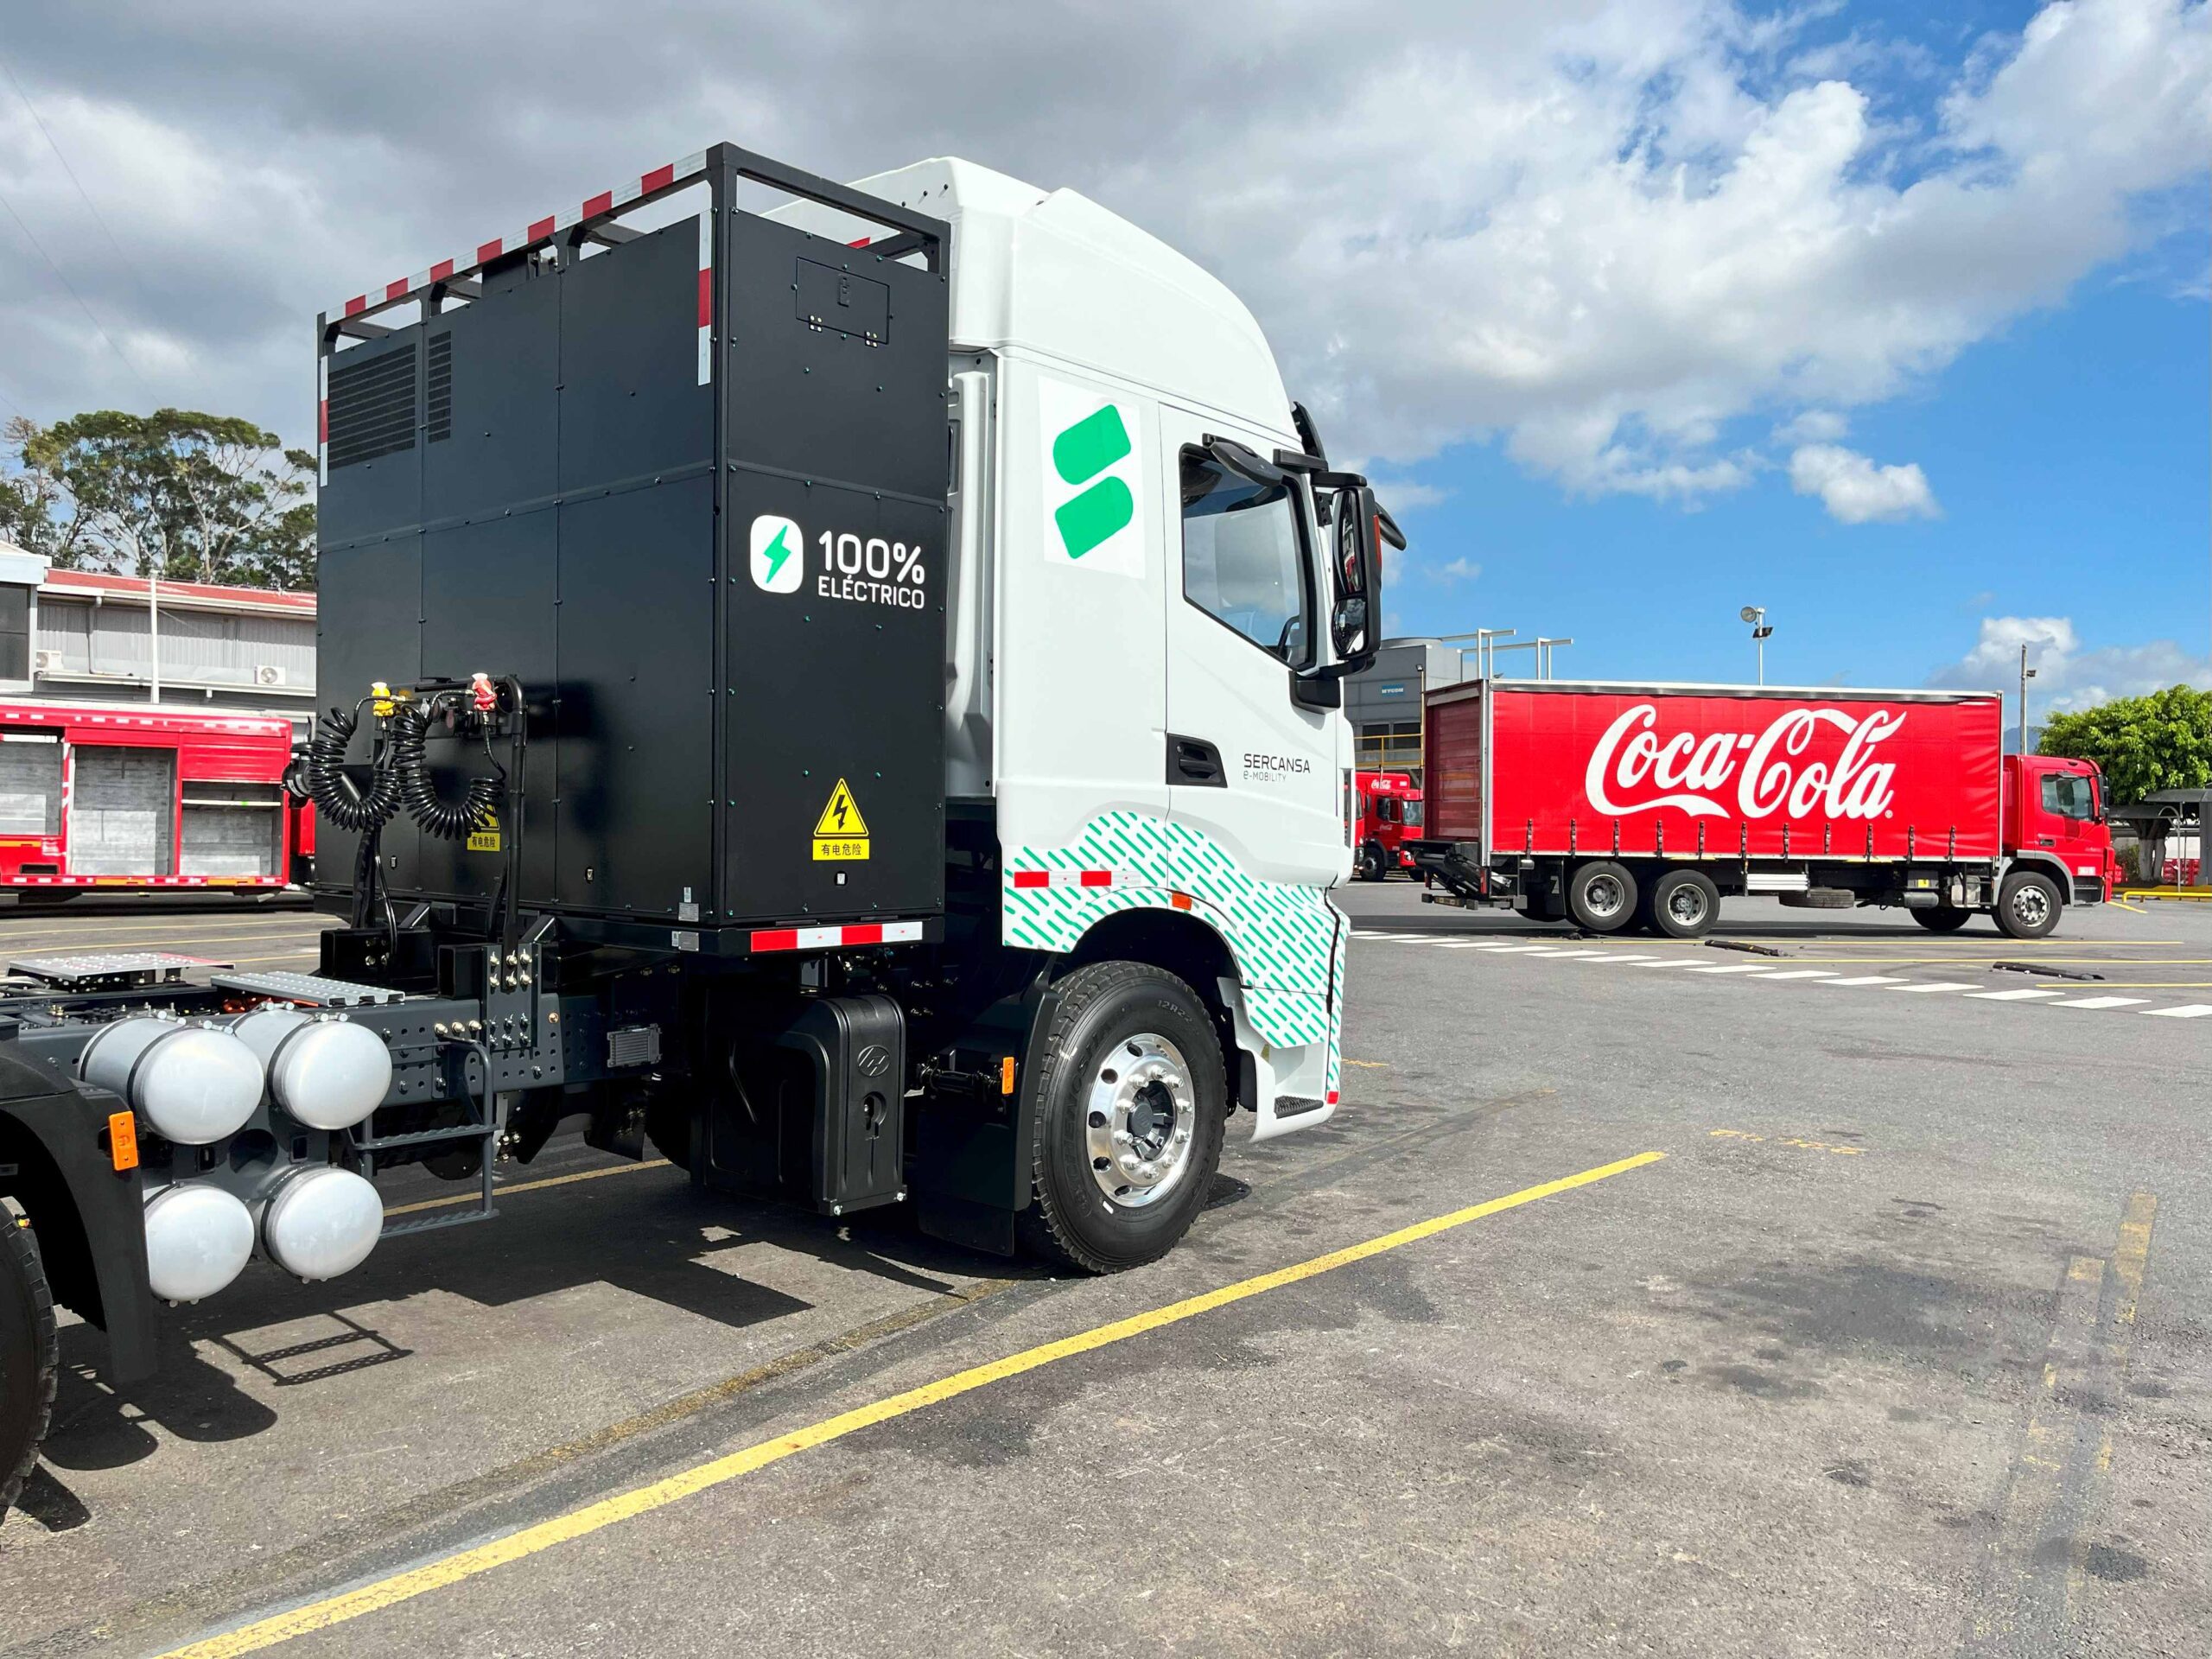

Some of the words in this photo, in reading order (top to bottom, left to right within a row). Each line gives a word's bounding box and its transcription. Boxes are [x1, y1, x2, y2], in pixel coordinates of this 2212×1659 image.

[818, 530, 925, 585] 100%
[818, 574, 925, 609] ELÉCTRICO
[1243, 753, 1311, 774] SERCANSA
[1585, 703, 1907, 819] Coca-Cola
[1243, 770, 1287, 782] e-MOBILITY
[821, 843, 861, 856] 有电危险
